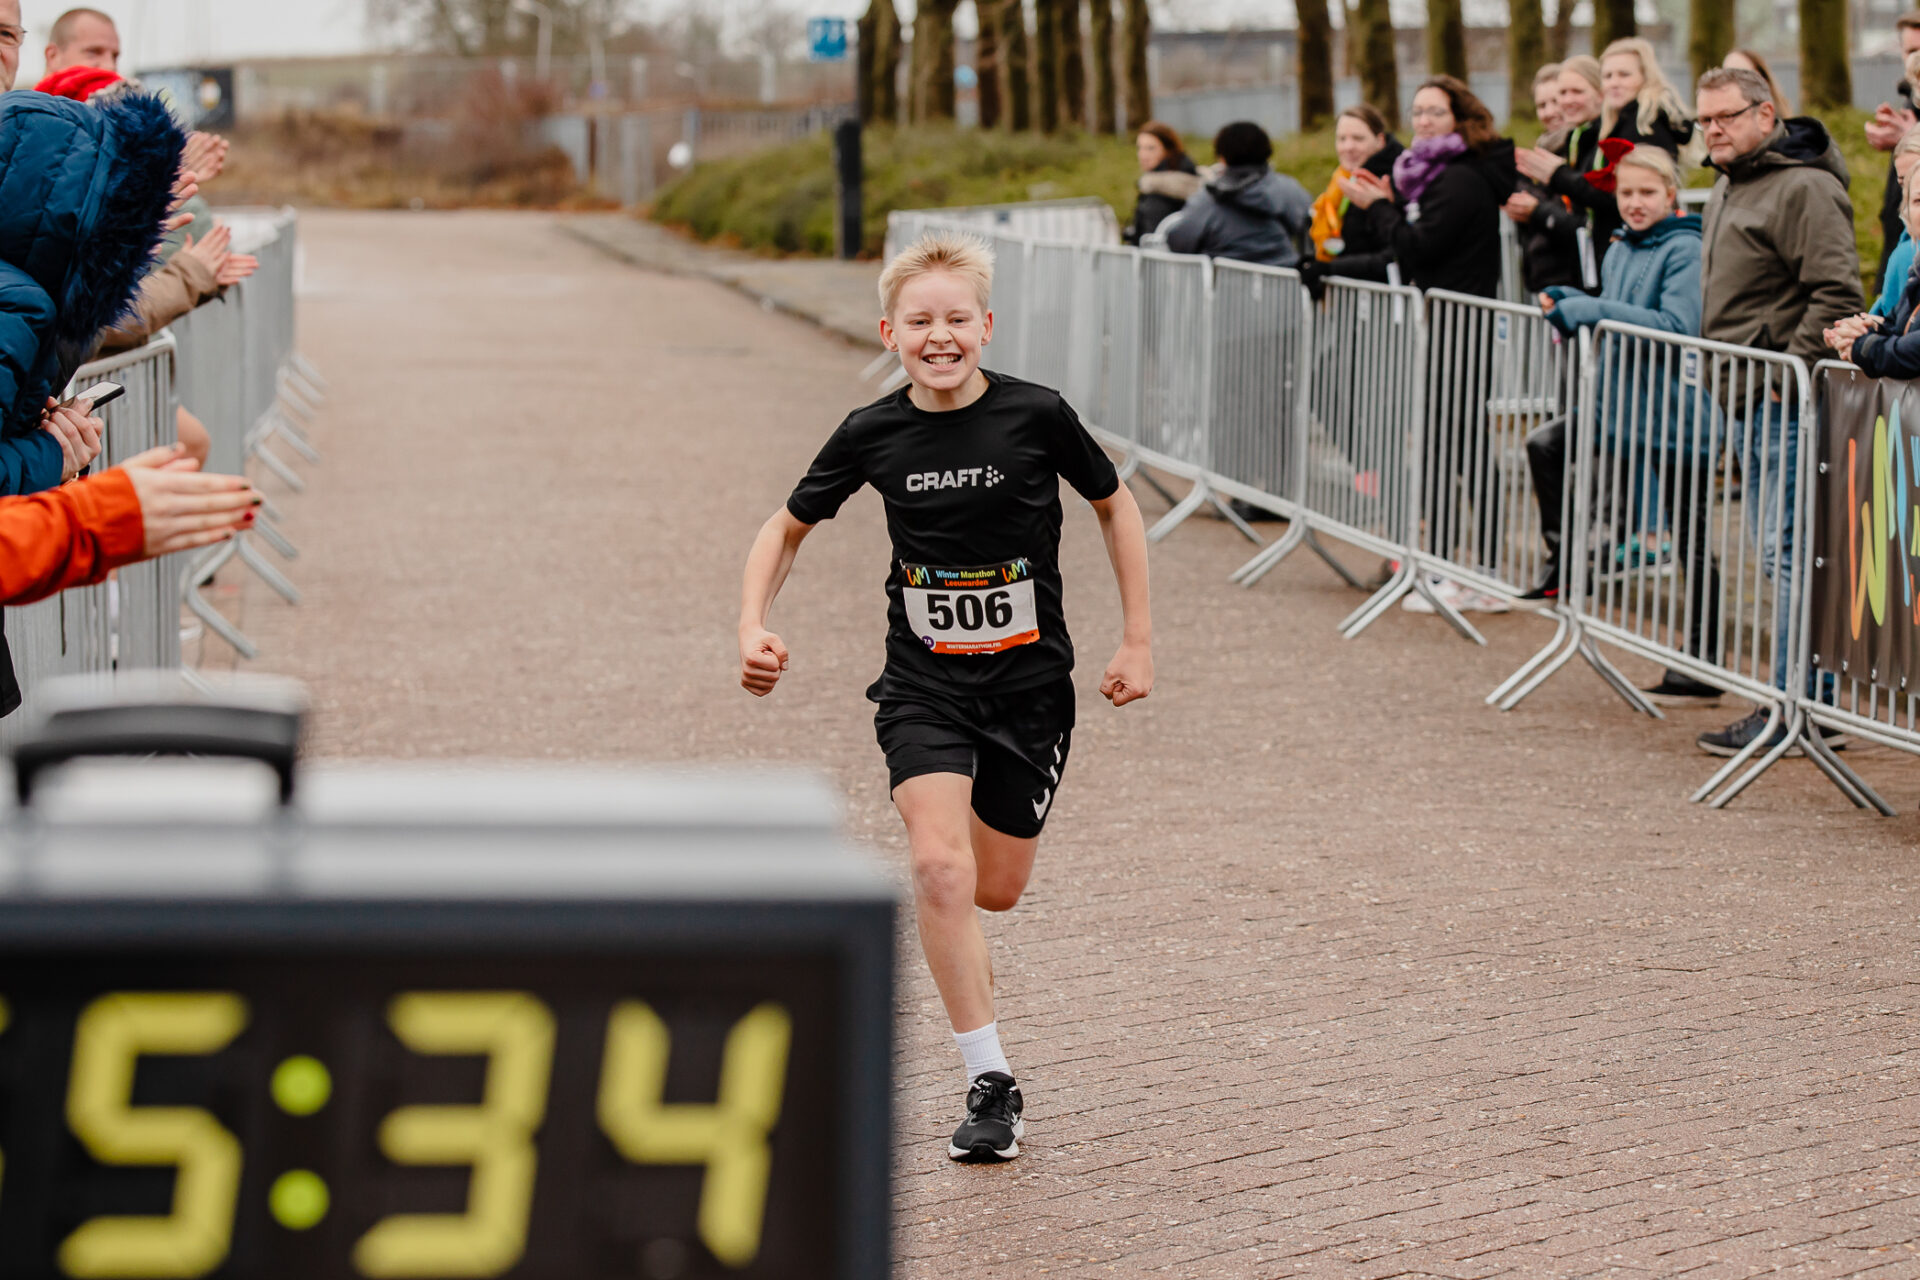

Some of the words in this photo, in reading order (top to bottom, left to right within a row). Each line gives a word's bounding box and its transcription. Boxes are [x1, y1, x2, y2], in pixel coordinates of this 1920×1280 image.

[906, 468, 983, 492] CRAFT
[936, 570, 960, 579] Winter
[960, 570, 996, 579] Marathon
[944, 579, 989, 587] Leeuwarden
[927, 591, 1013, 631] 506
[0, 990, 793, 1279] 5:34
